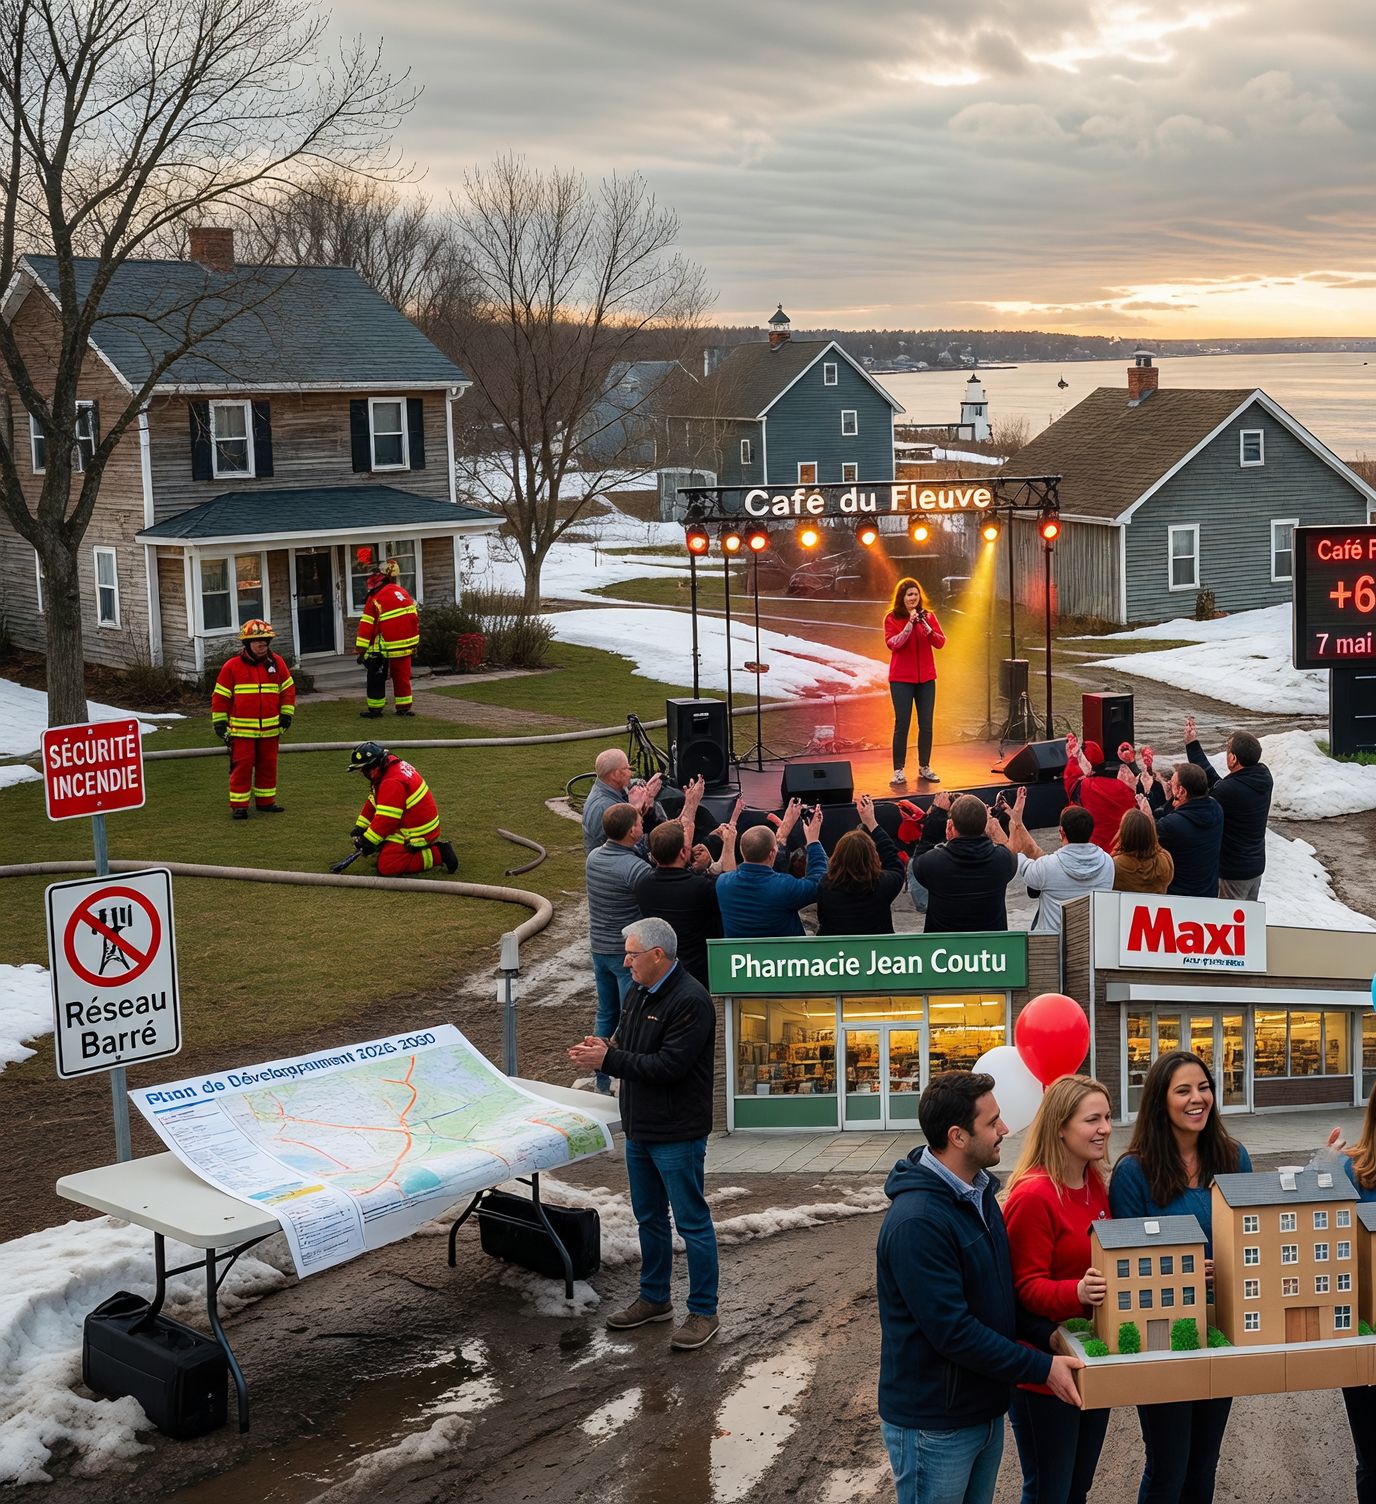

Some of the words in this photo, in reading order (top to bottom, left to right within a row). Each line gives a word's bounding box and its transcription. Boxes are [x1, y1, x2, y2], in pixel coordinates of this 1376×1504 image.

[744, 488, 825, 516] Café
[839, 487, 877, 513] du
[890, 484, 992, 512] Fleuve
[1317, 538, 1363, 560] Café
[1329, 574, 1376, 613] +6
[1315, 633, 1329, 655] 7
[1336, 632, 1372, 654] mai
[53, 765, 139, 800] INCENDIE
[1127, 905, 1246, 956] Maxi
[730, 951, 860, 978] Pharmacie
[866, 950, 923, 976] Jean
[930, 948, 1006, 974] Coutu
[65, 991, 167, 1029] Réseau
[81, 1019, 157, 1059] Barré
